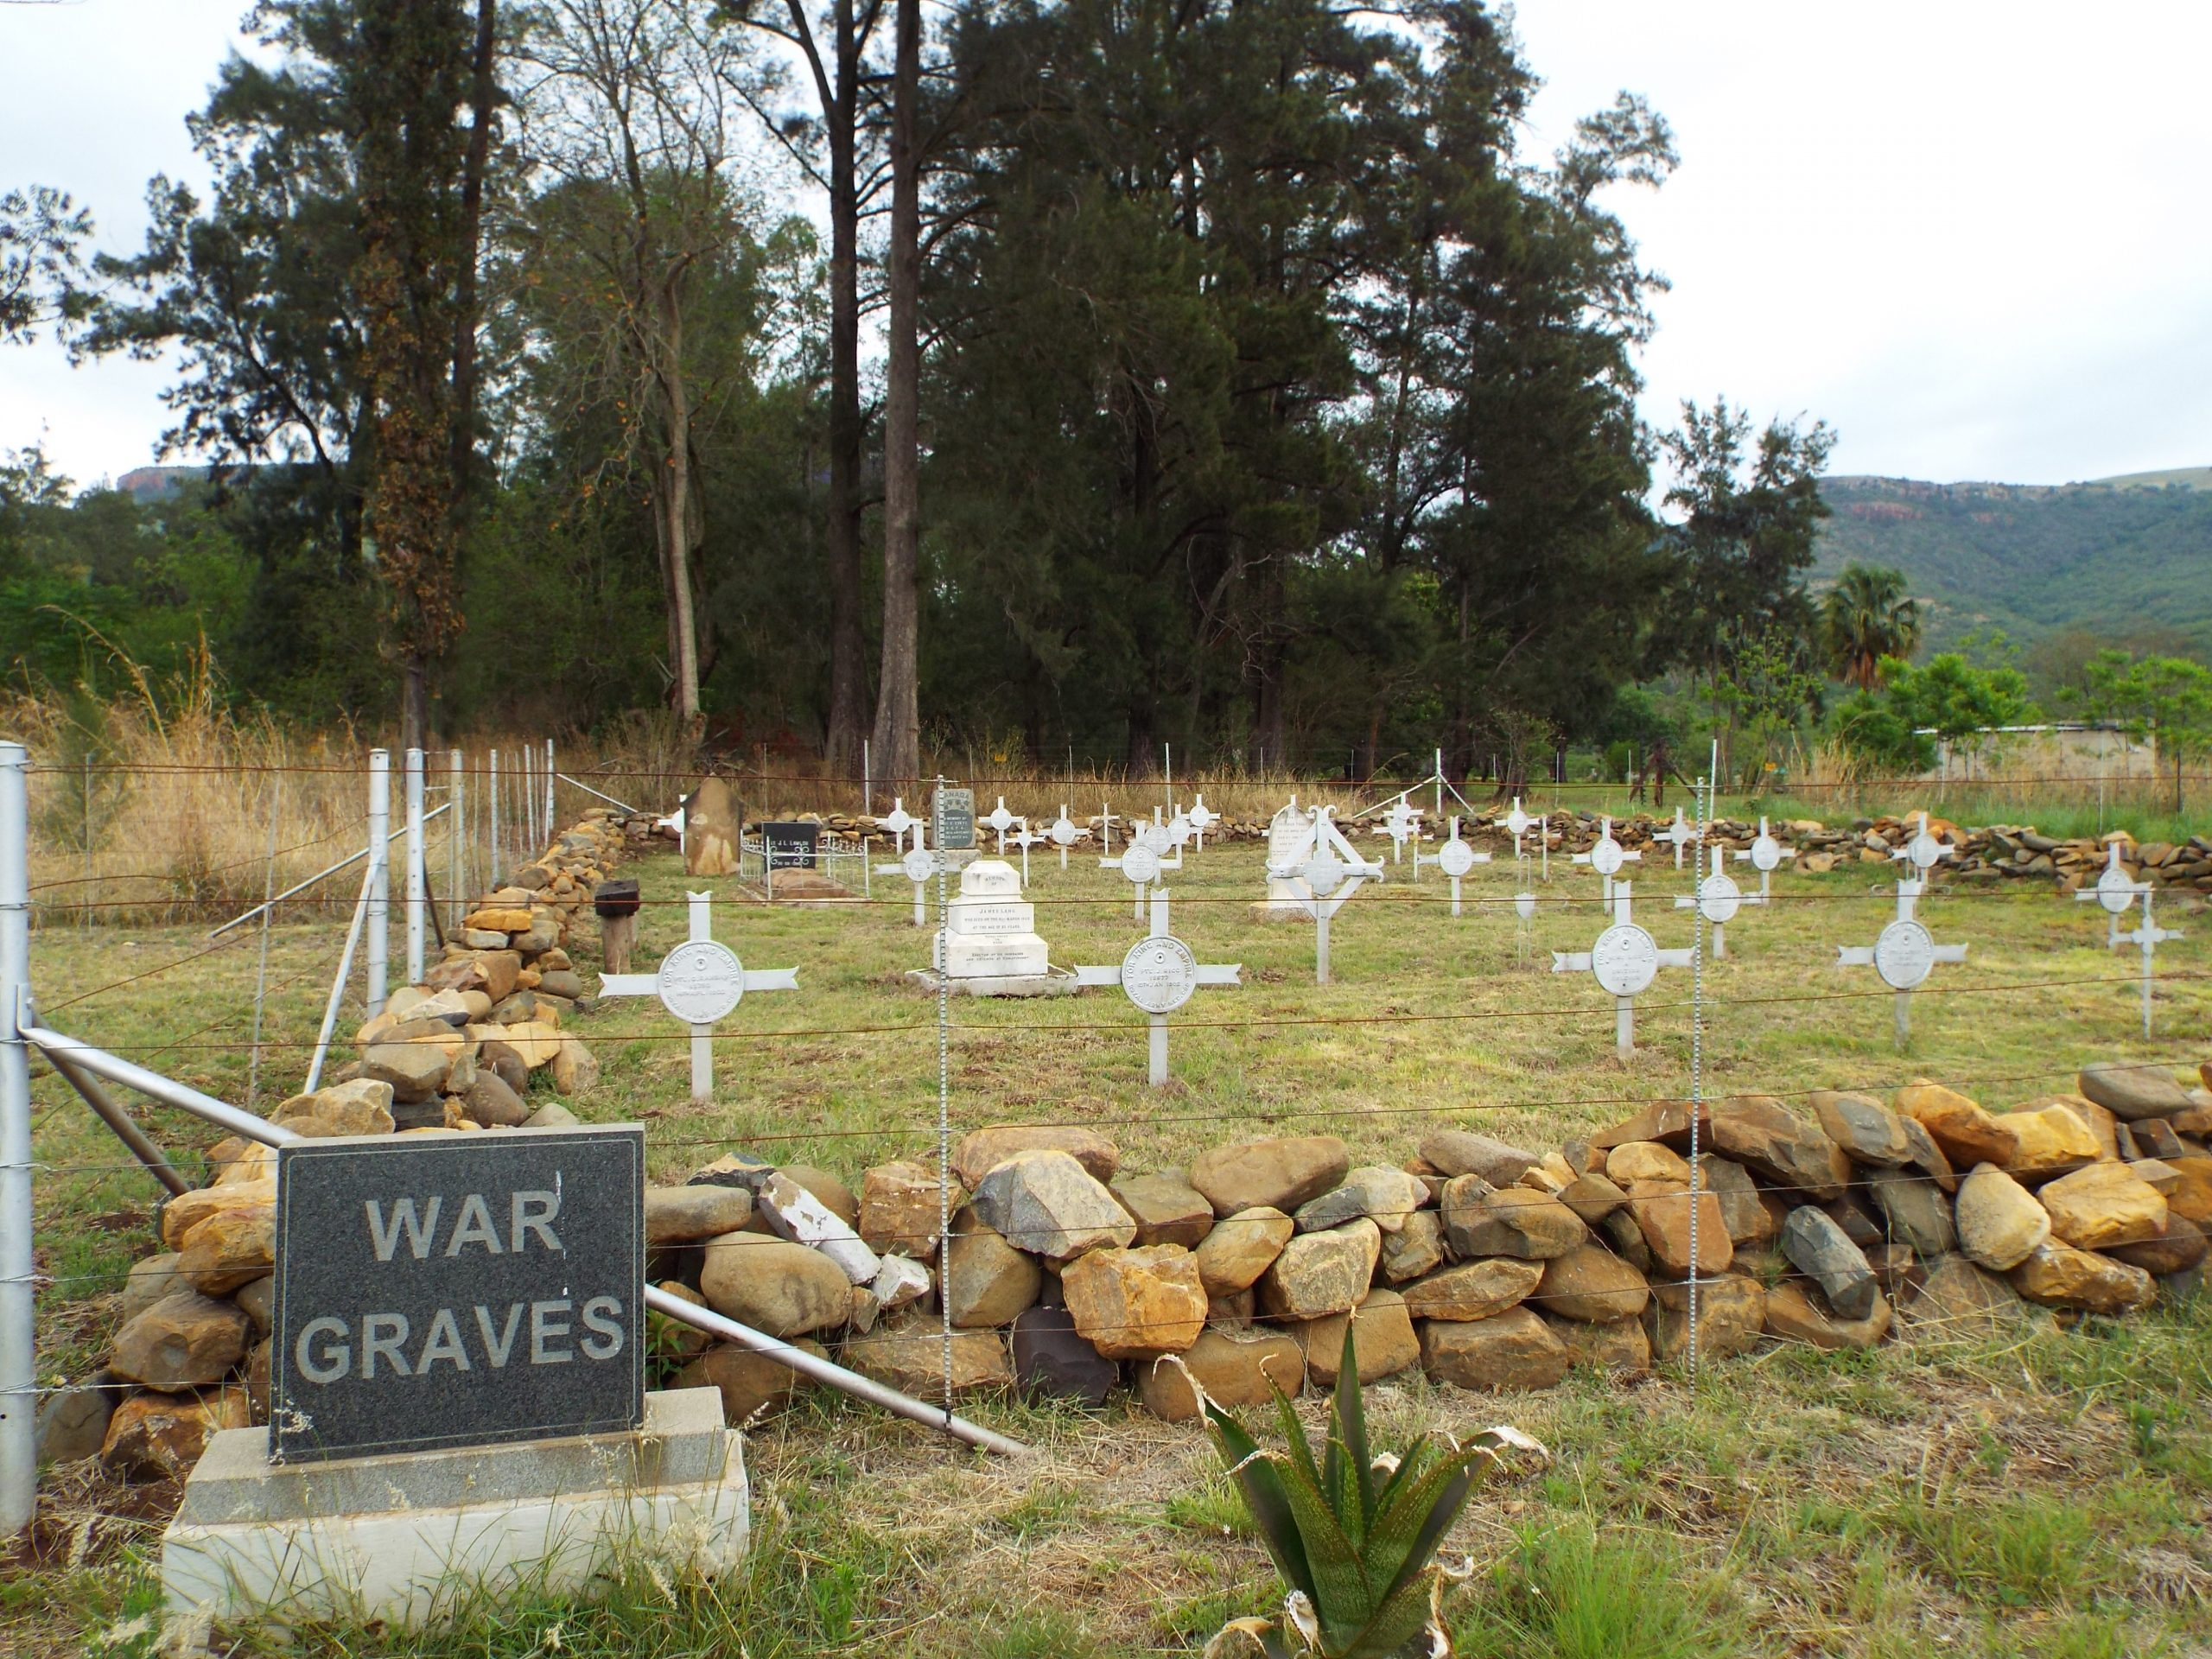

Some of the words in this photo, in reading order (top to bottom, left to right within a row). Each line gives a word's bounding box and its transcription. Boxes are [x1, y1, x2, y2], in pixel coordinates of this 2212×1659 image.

[1126, 962, 1136, 979] FOR
[365, 1188, 564, 1262] WAR
[294, 1294, 625, 1385] GRAVES
